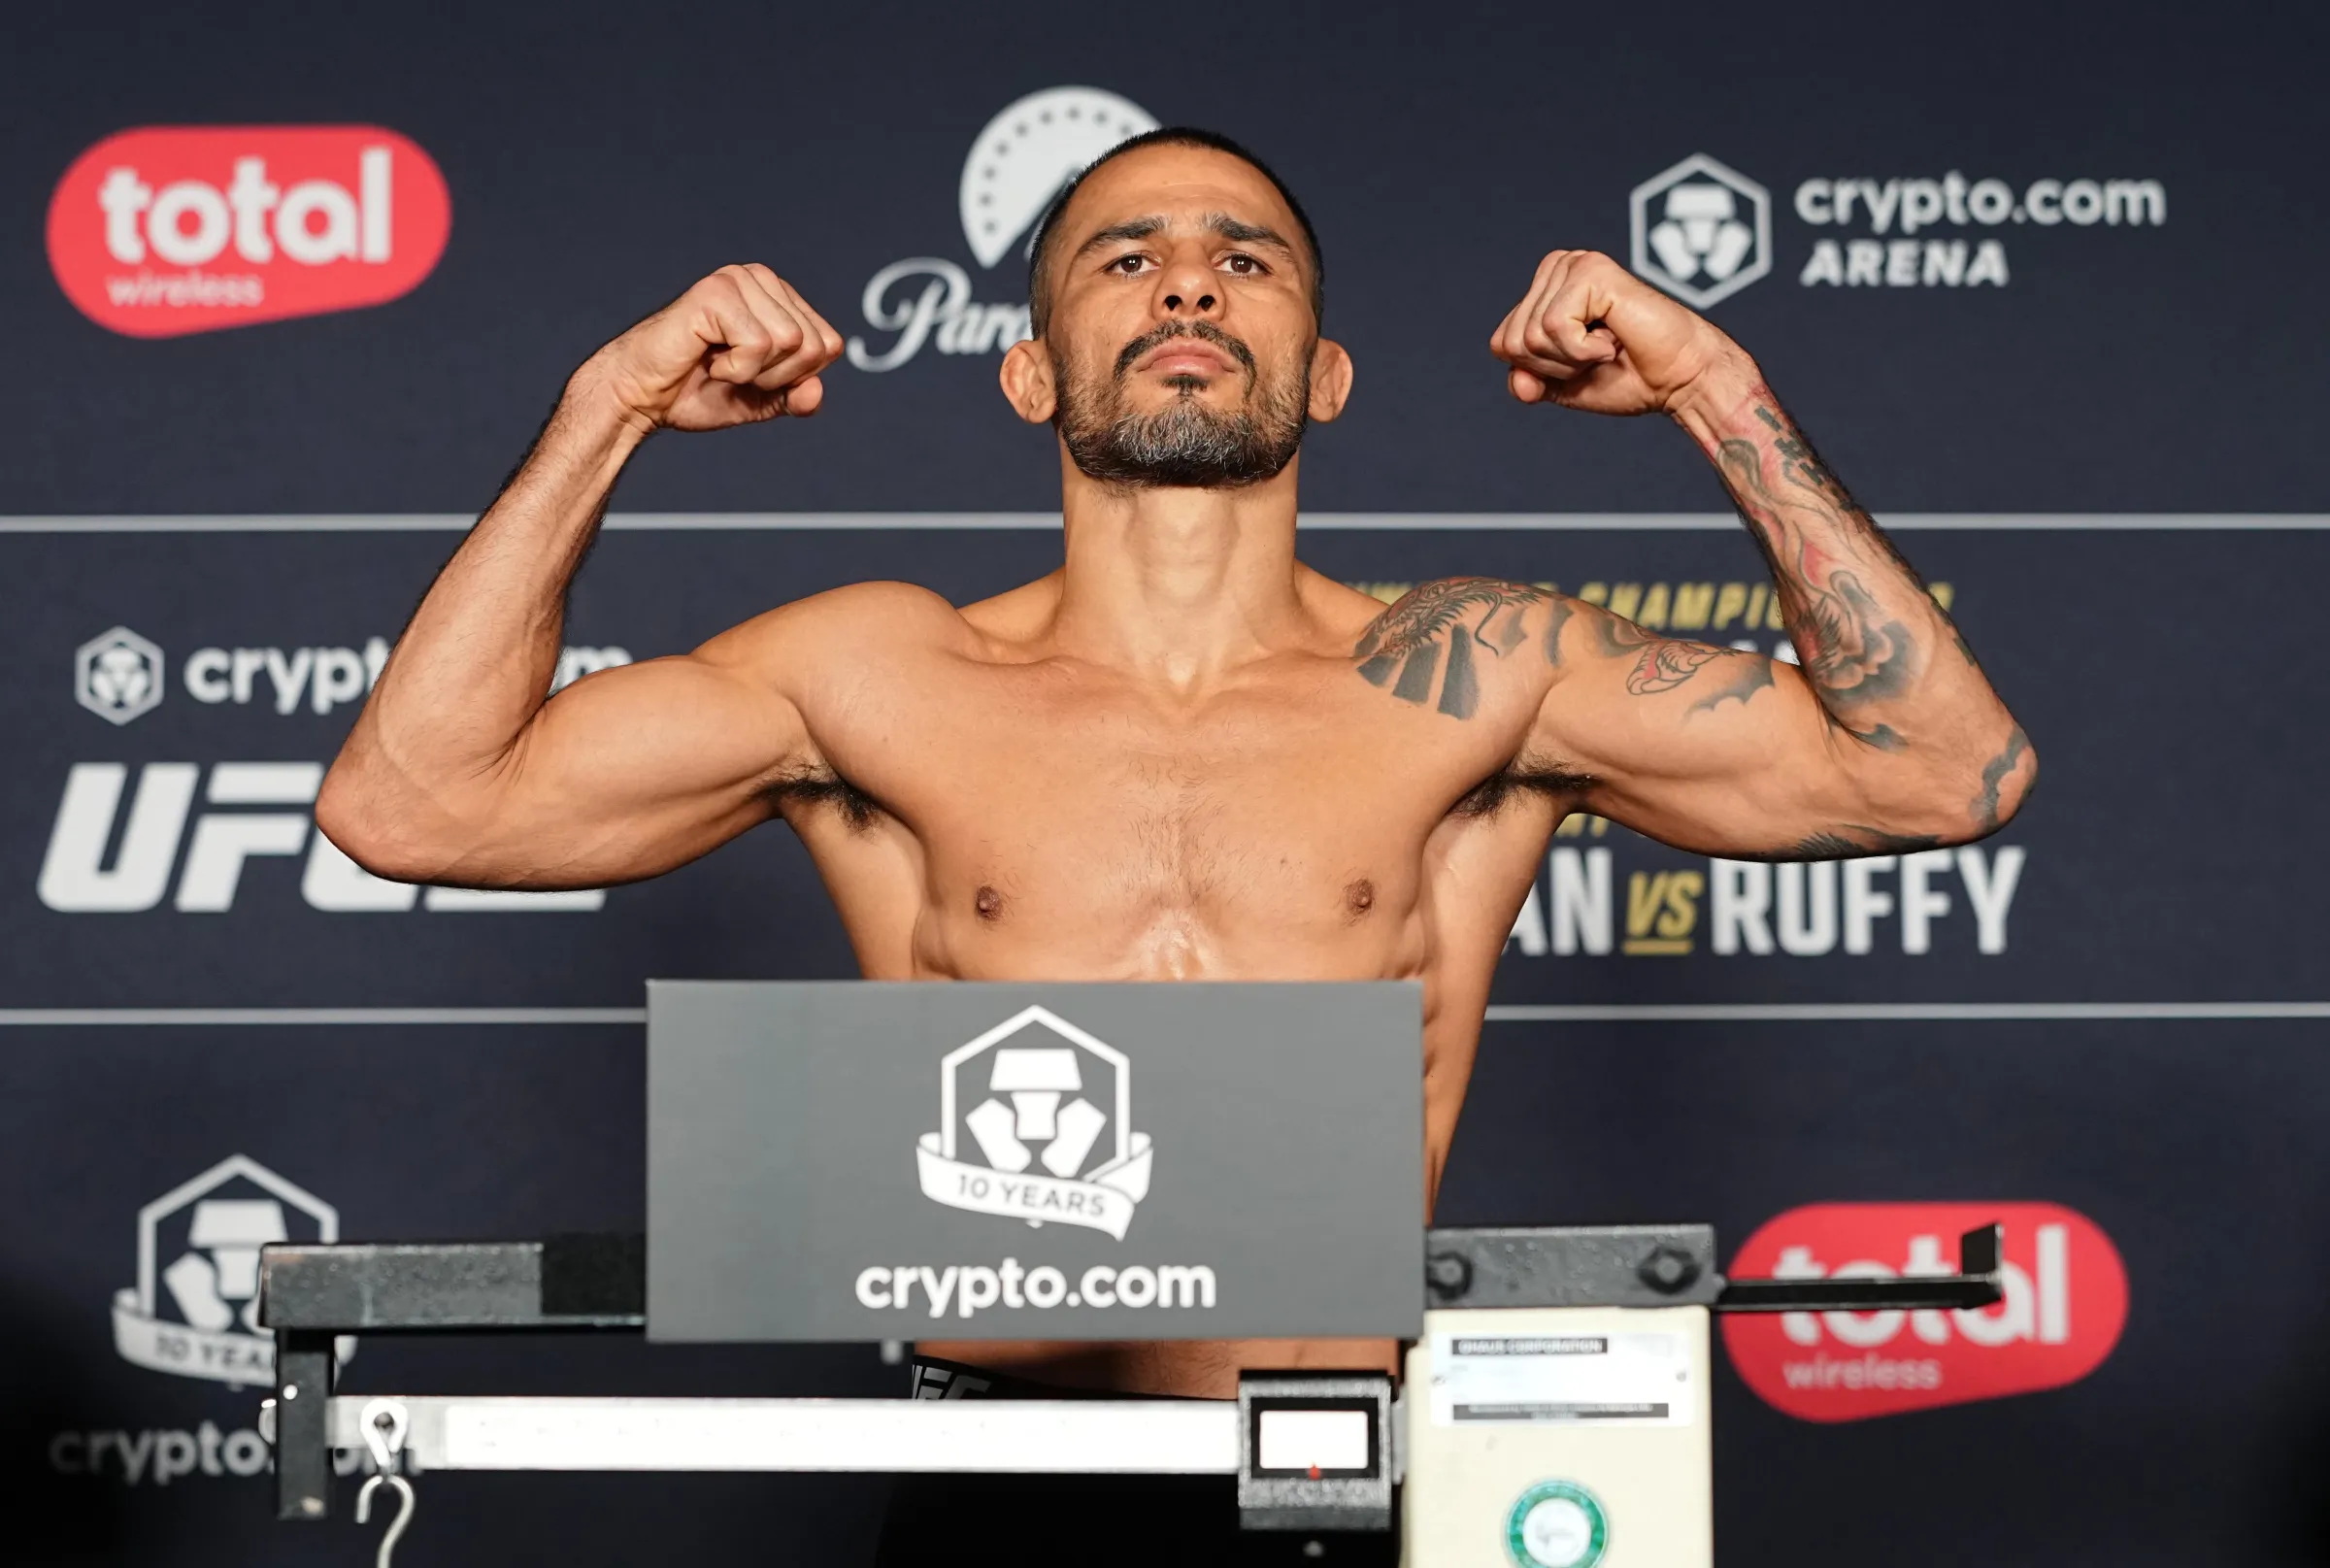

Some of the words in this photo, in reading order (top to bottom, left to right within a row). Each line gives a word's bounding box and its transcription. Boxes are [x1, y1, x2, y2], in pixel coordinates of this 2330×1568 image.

[99, 146, 392, 264] total
[1794, 169, 2167, 235] crypto.com
[107, 269, 264, 307] wireless
[1799, 238, 2011, 288] ARENA
[1710, 844, 2026, 956] RUFFY
[959, 1173, 990, 1200] 10
[1000, 1181, 1106, 1217] YEARS
[854, 1256, 1216, 1318] crypto.com
[198, 1340, 276, 1367] YEA
[1783, 1351, 1941, 1389] wireless
